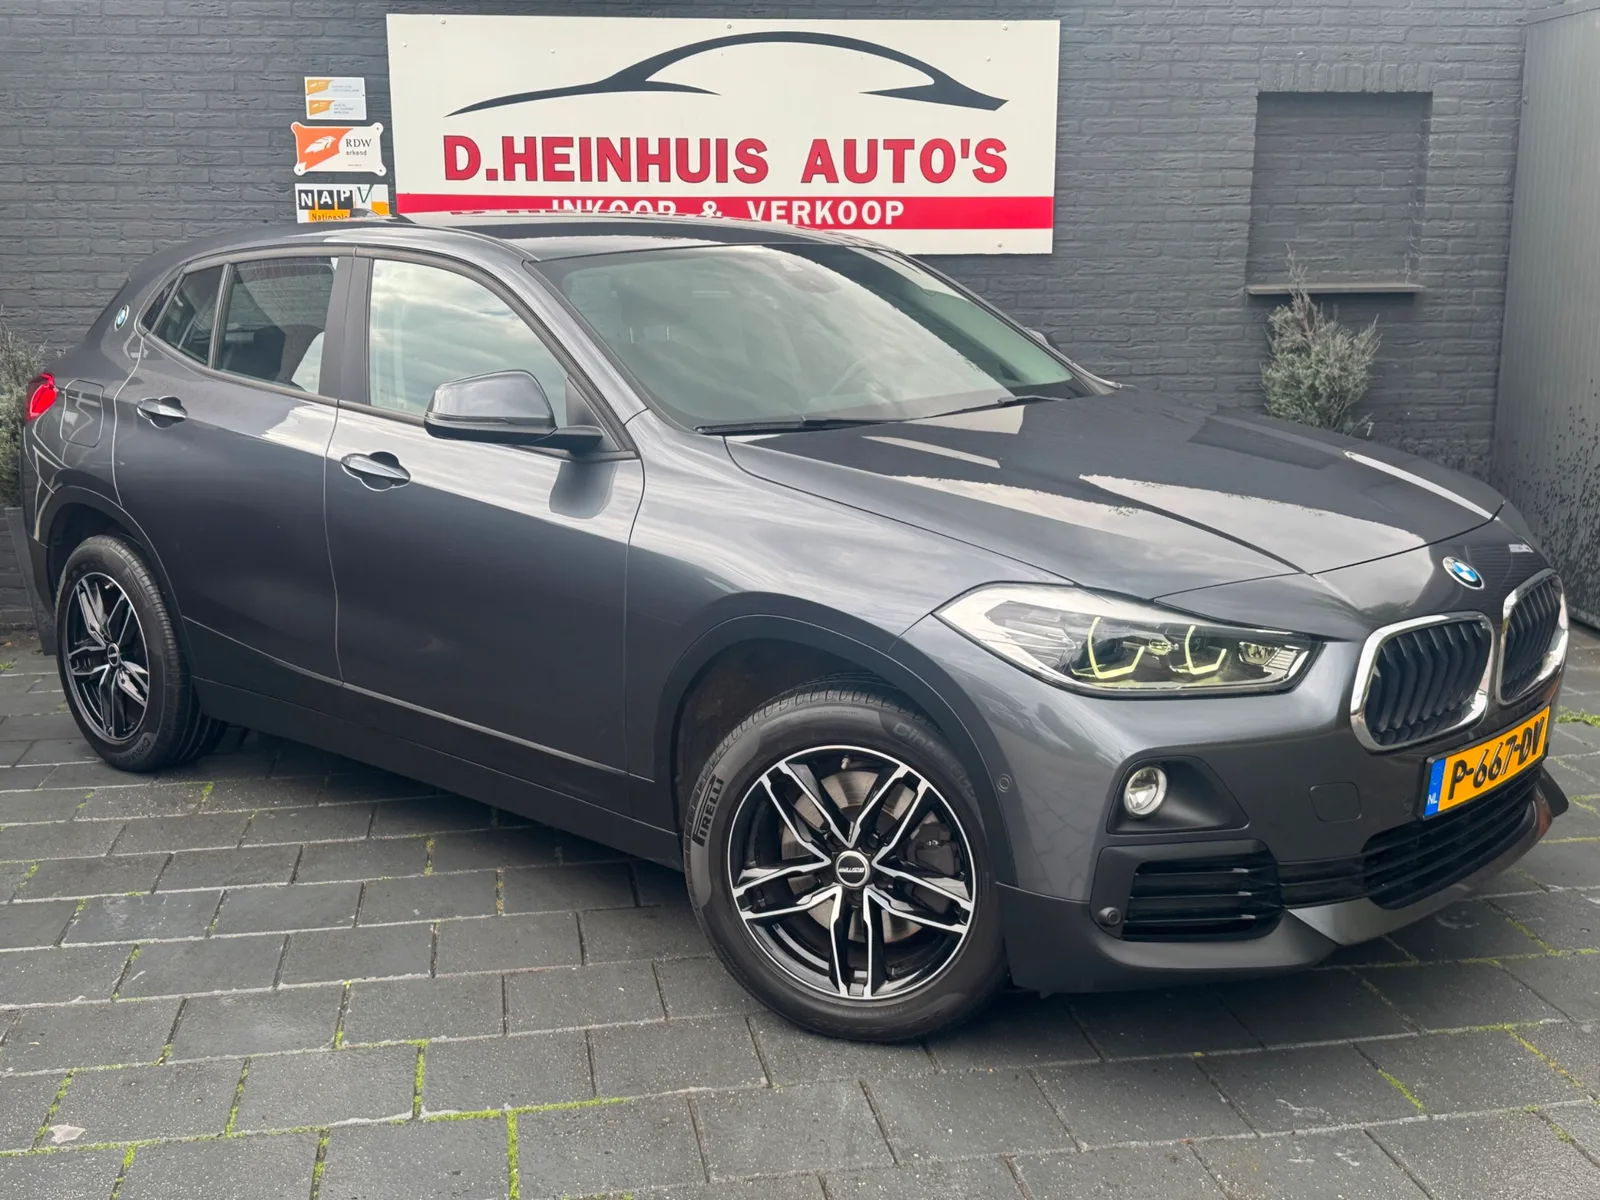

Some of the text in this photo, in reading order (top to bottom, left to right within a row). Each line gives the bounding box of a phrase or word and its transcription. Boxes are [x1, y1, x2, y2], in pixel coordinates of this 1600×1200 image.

[345, 138, 372, 148] RDW
[443, 135, 1008, 185] D.HEINHUIS AUTO'S
[746, 200, 904, 226] VERKOOP
[1447, 716, 1545, 801] P-667-DV
[692, 773, 724, 848] PIRELLI
[1427, 792, 1438, 806] NL
